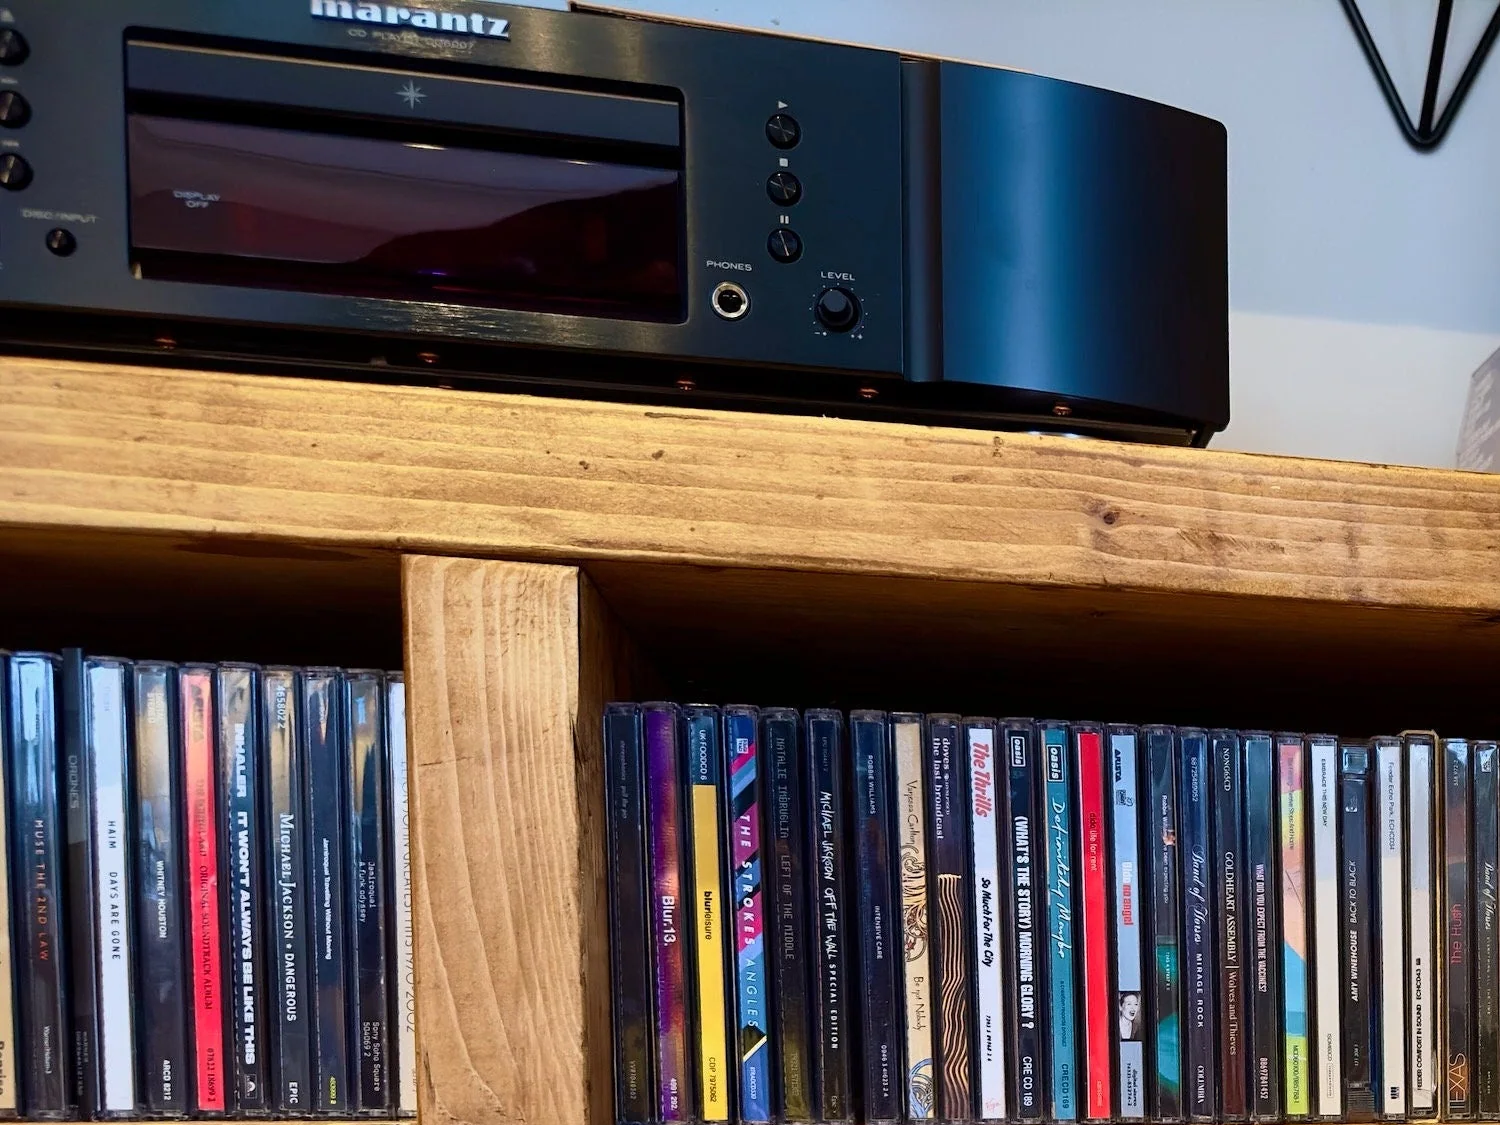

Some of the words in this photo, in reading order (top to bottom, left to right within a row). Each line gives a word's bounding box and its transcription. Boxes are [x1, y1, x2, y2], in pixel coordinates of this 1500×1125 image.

[310, 0, 510, 37] marantz
[706, 260, 752, 272] PHONES
[820, 271, 856, 282] LEVEL
[235, 722, 247, 798] INHALER
[932, 737, 942, 756] the
[942, 737, 952, 770] doves
[972, 742, 990, 768] The
[1012, 738, 1024, 765] oasis
[933, 757, 943, 780] last
[1049, 747, 1062, 780] oasis
[1222, 747, 1231, 791] NONG65CD
[974, 770, 990, 817] Thrills
[237, 810, 250, 828] IT
[934, 783, 944, 839] broadcast
[34, 819, 44, 856] MUSE
[107, 820, 117, 849] HAIM
[278, 813, 294, 879] MICHAEL
[739, 814, 751, 848] THE
[1014, 815, 1030, 863] (WHAT'S
[238, 830, 251, 887] WON'T
[821, 840, 835, 880] JACKSON
[1051, 798, 1069, 898] Definitely
[35, 864, 45, 891] THE
[155, 860, 164, 897] WHITNEY
[1015, 866, 1030, 886] THE
[1191, 850, 1204, 883] Band
[1224, 851, 1235, 911] GOLDHEART
[1254, 864, 1264, 880] WHAT
[108, 871, 119, 900] DAYS
[981, 877, 992, 889] So
[1255, 882, 1265, 893] DID
[36, 897, 46, 925] 2ND
[279, 880, 296, 938] JACKSON
[741, 860, 755, 946] STROKES
[824, 887, 836, 910] OFF
[981, 890, 992, 915] Much
[1016, 888, 1032, 929] STORY)
[1189, 897, 1205, 910] of
[1255, 894, 1265, 907] YOU
[109, 904, 120, 926] ARE
[157, 898, 166, 938] HOUSTON
[239, 889, 252, 960] ALWAYS
[826, 912, 837, 931] THE
[982, 916, 992, 931] For
[1192, 906, 1208, 944] Horses
[1256, 908, 1266, 929] EXPECT
[37, 931, 48, 961] LAW
[110, 930, 121, 960] GONE
[983, 932, 993, 947] The
[1051, 903, 1071, 959] Maybe
[1225, 914, 1236, 962] ASSEMBLY
[1256, 930, 1266, 947] FROM
[826, 934, 837, 960] WALL
[981, 947, 994, 967] City
[1018, 931, 1032, 982] MORNING
[1256, 947, 1266, 961] THE
[242, 961, 254, 983] BE
[284, 953, 297, 1021] DANGEROUS
[828, 963, 837, 1003] SPECIAL
[1195, 952, 1204, 995] MIRAGE
[1227, 971, 1237, 1001] Wolves
[1257, 962, 1266, 992] VACCINES?
[243, 985, 254, 1021] LIKE
[745, 958, 758, 1027] ANGLES
[1019, 983, 1033, 1018] GLORY
[1196, 999, 1204, 1028] ROCK
[1228, 1004, 1238, 1019] and
[243, 1023, 256, 1064] THIS
[829, 1009, 839, 1049] EDITION
[1228, 1021, 1239, 1056] Thieves
[288, 1081, 299, 1104] EPIC
[1022, 1074, 1032, 1090] CD
[1197, 1064, 1205, 1104] COLUMBIA
[1022, 1092, 1034, 1106] 189
